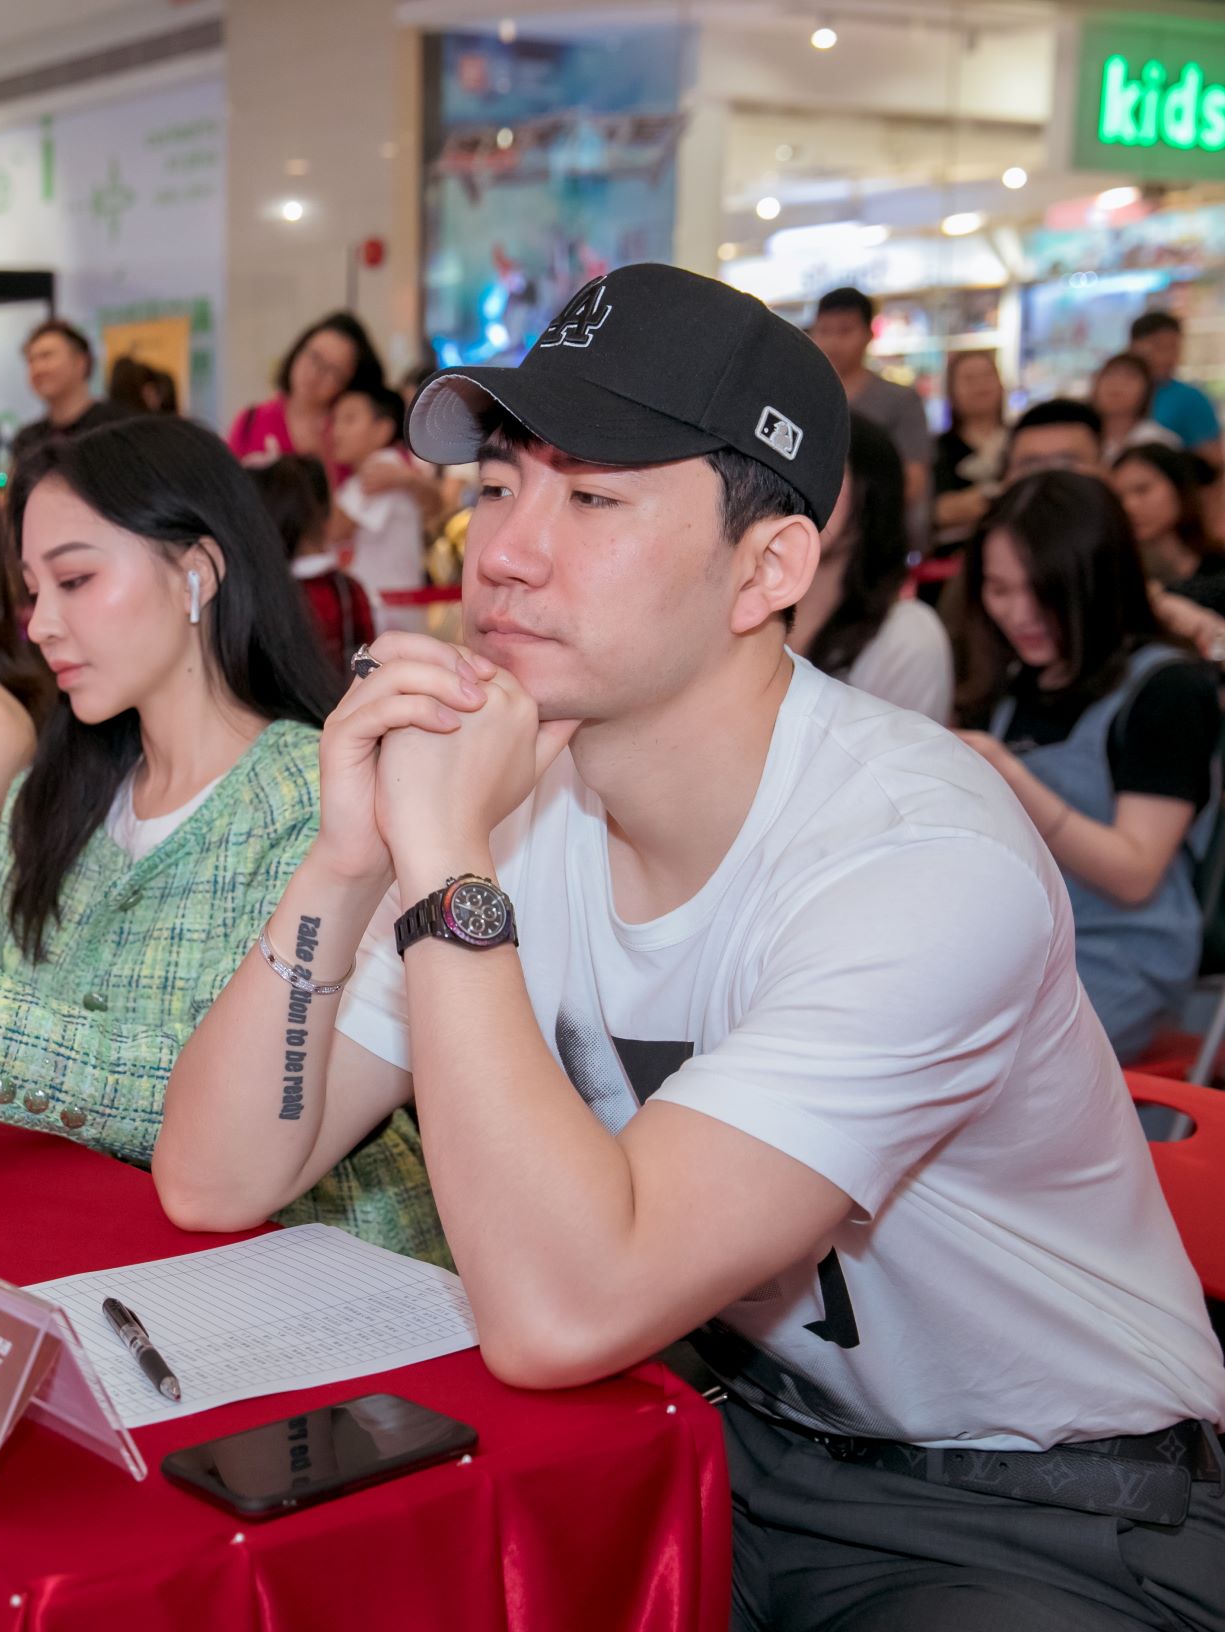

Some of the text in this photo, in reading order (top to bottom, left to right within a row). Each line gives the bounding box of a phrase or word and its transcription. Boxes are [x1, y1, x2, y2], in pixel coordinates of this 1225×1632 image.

[1098, 54, 1225, 151] kids
[278, 915, 321, 1121] Take ation to be ready
